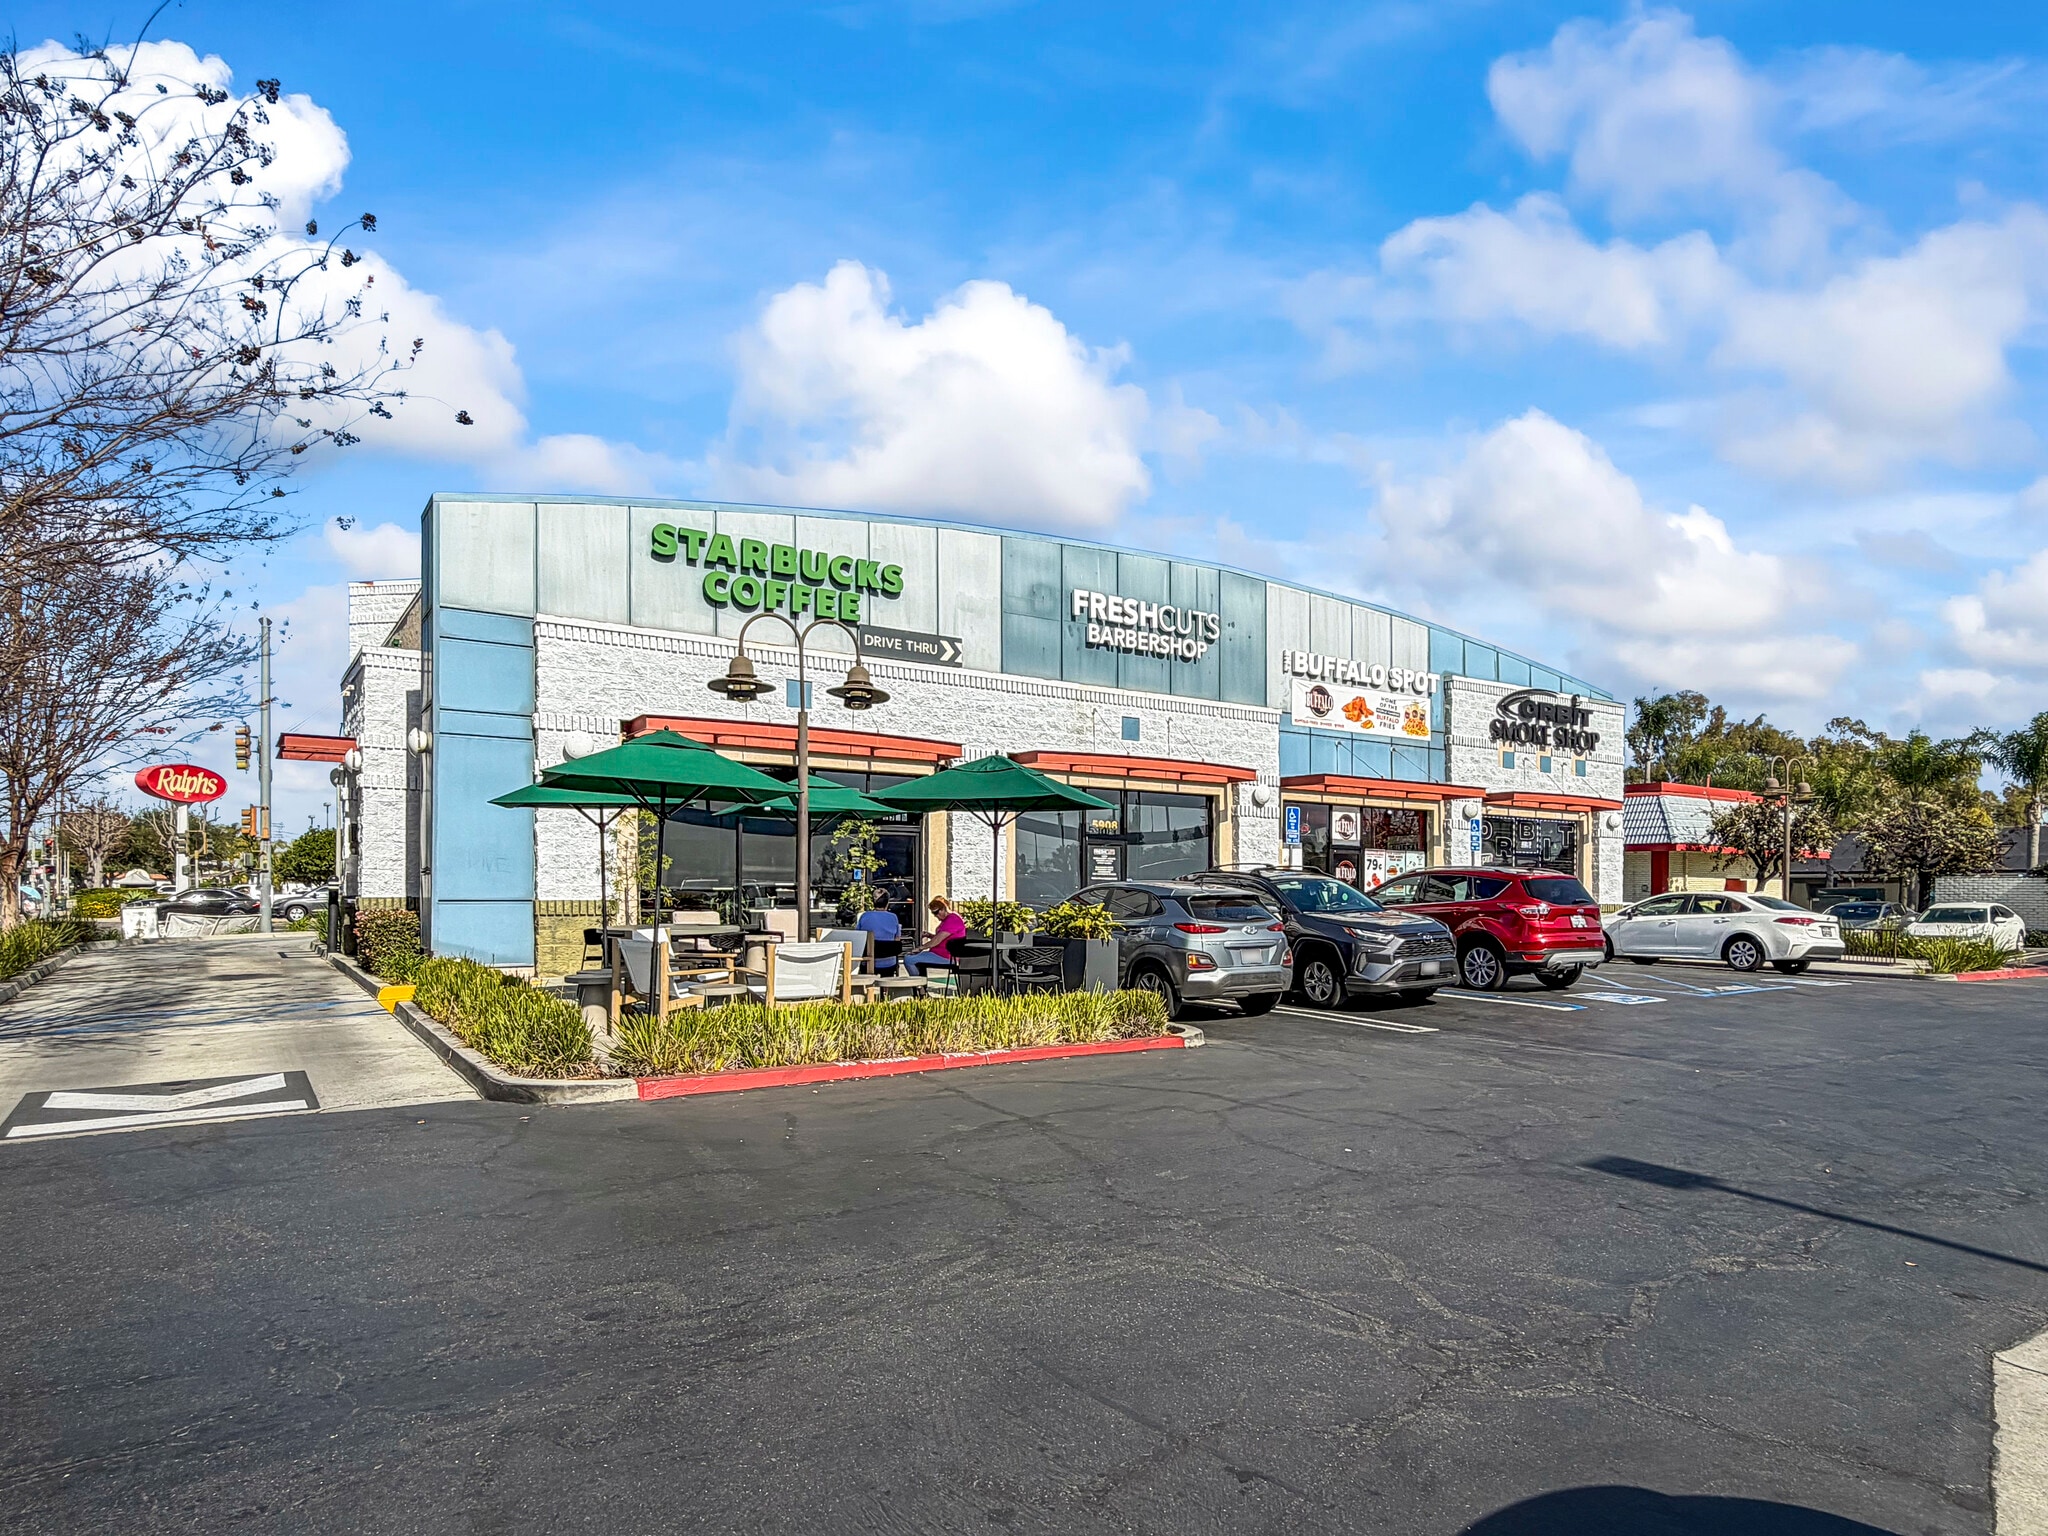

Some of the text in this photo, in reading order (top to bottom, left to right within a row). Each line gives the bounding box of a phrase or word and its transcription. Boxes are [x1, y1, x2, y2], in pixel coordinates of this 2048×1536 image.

[651, 523, 904, 597] STARBUCKS
[703, 571, 860, 622] COFFEE
[1072, 588, 1220, 640] FRESHCUTS
[864, 634, 938, 656] DRIVE THRU
[1087, 623, 1208, 660] BARBERSHOP
[1292, 651, 1440, 695] BUFFALO SPOT
[1306, 691, 1334, 711] BUFFALO
[1518, 694, 1594, 727] ORBIT
[1489, 718, 1600, 756] SMOKE SHOP
[156, 767, 219, 798] Ralphs
[1091, 819, 1118, 831] 5908
